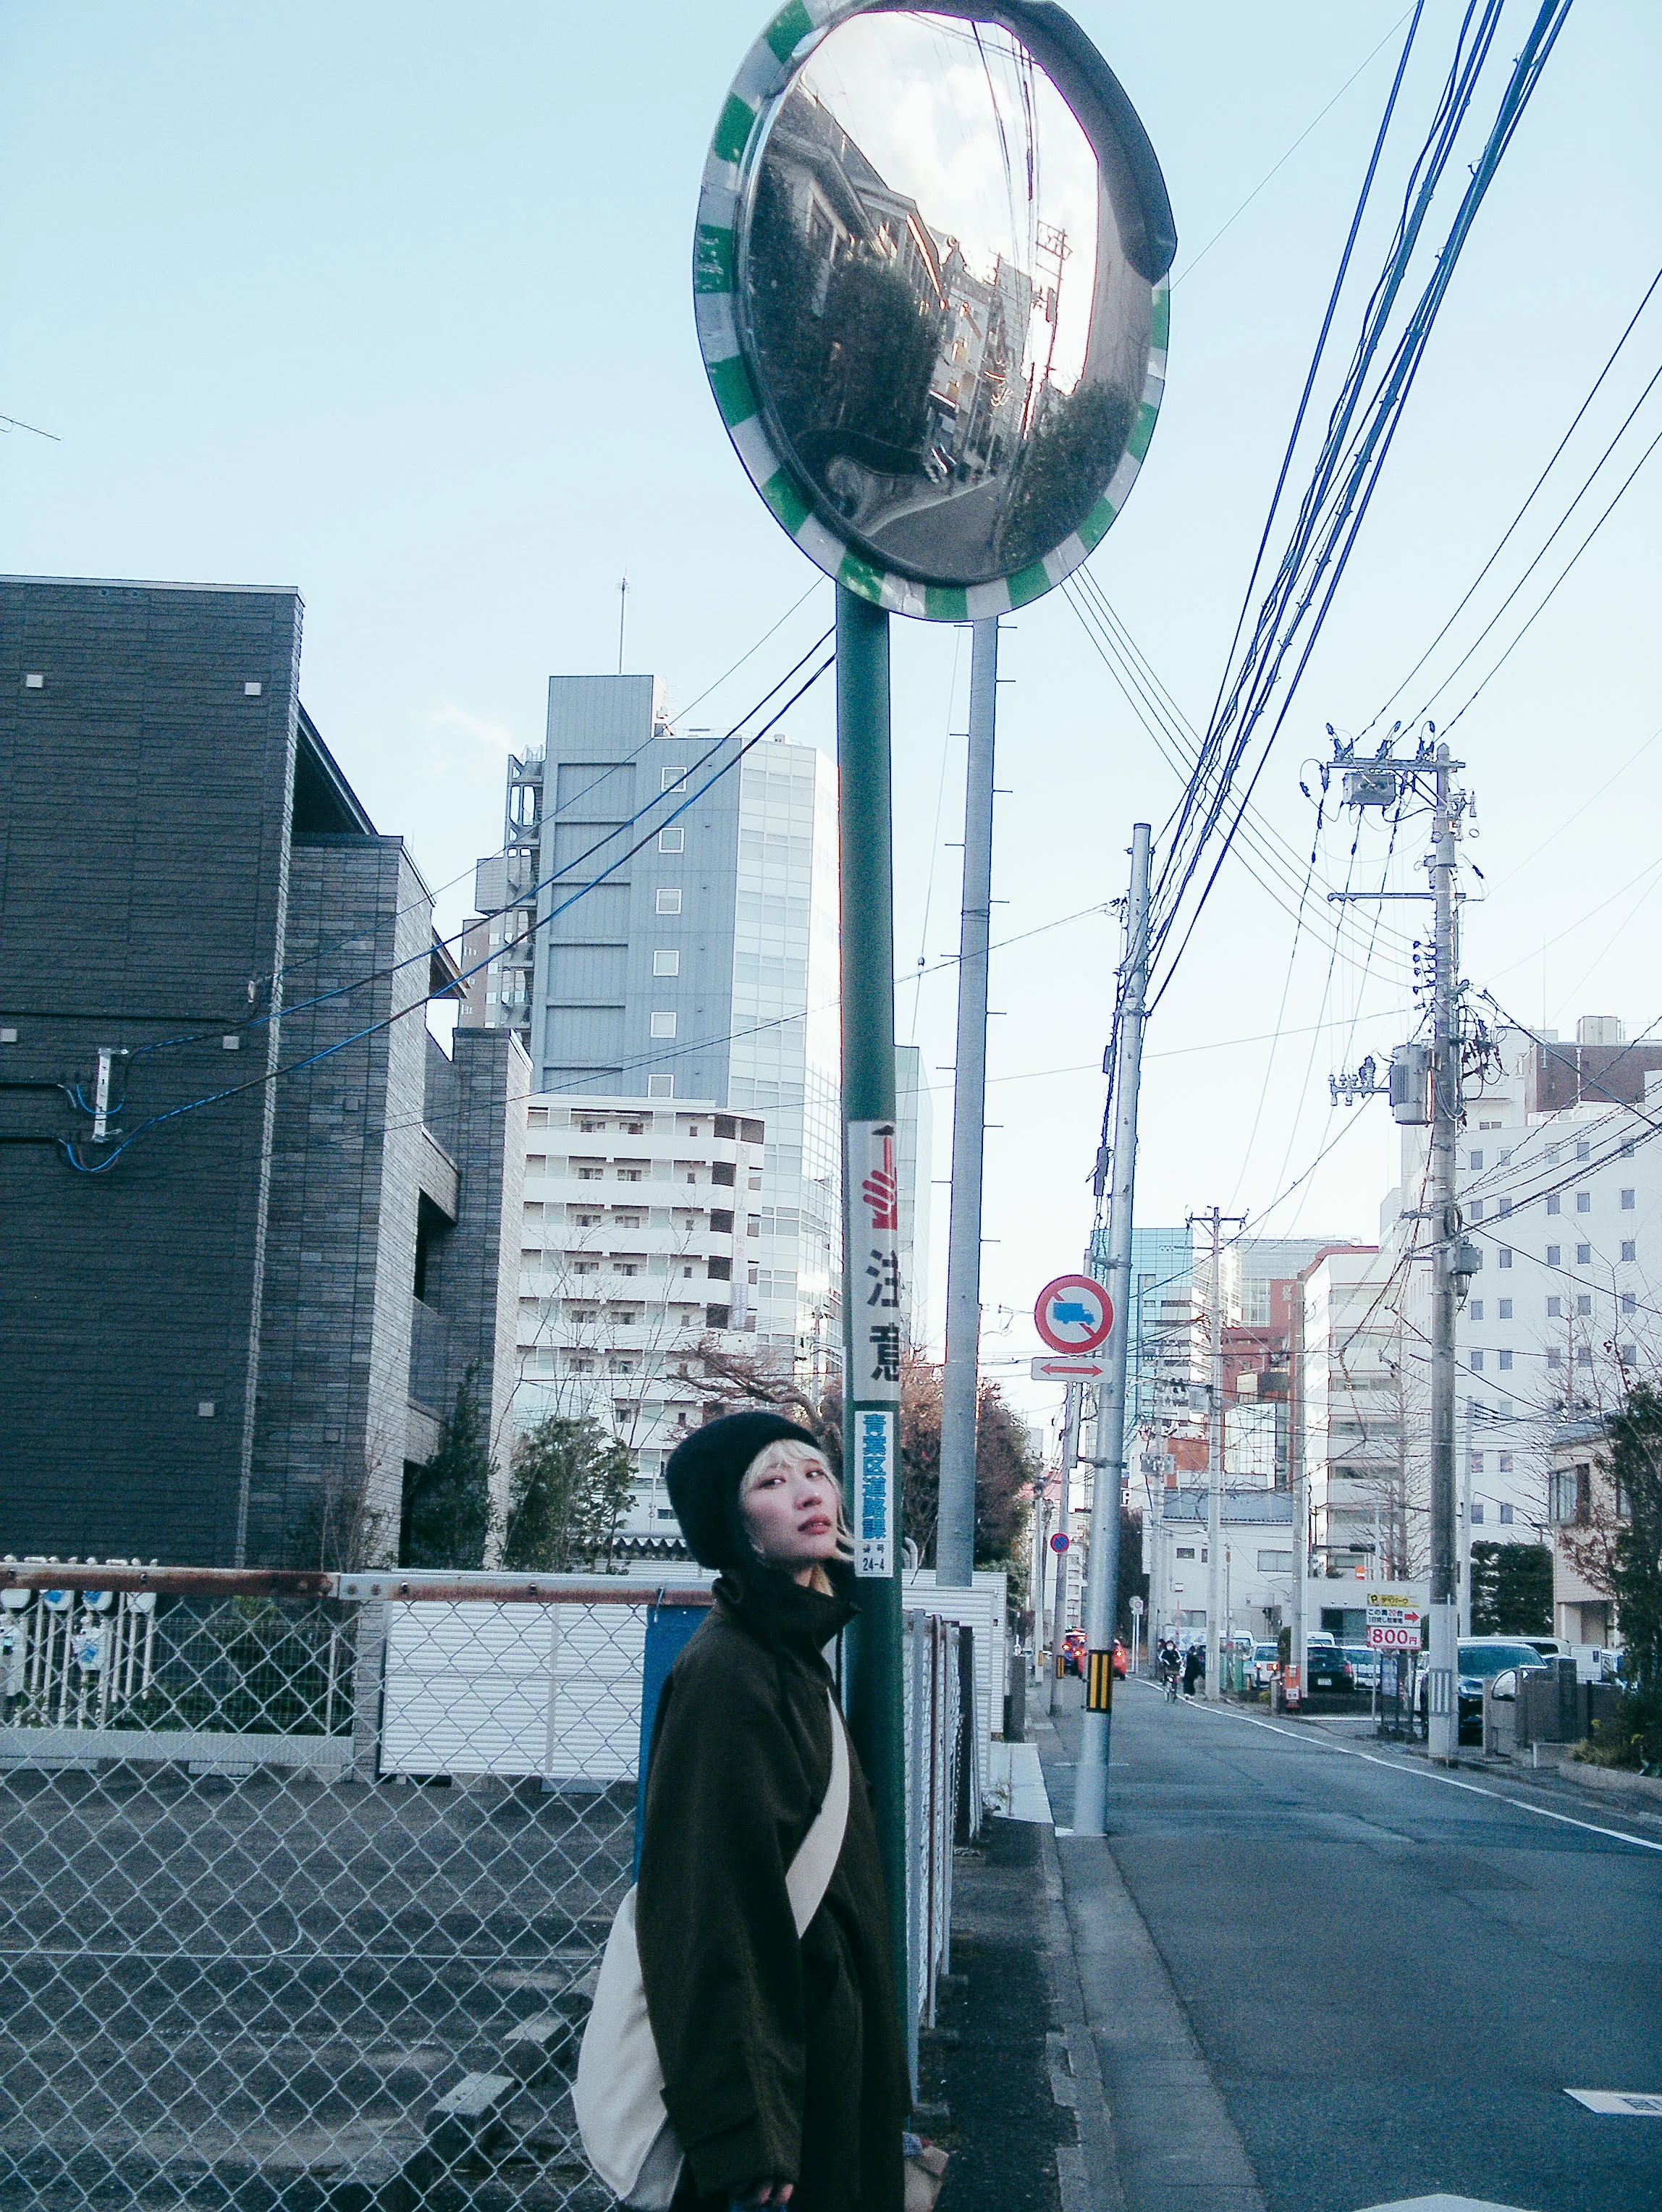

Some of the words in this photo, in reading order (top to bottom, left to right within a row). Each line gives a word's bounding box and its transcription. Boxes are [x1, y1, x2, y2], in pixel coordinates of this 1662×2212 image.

[866, 1249, 900, 1382] 注意
[861, 1413, 887, 1540] 青葉区道路課
[862, 1557, 885, 1571] 24-4
[1372, 1628, 1417, 1645] 800円
